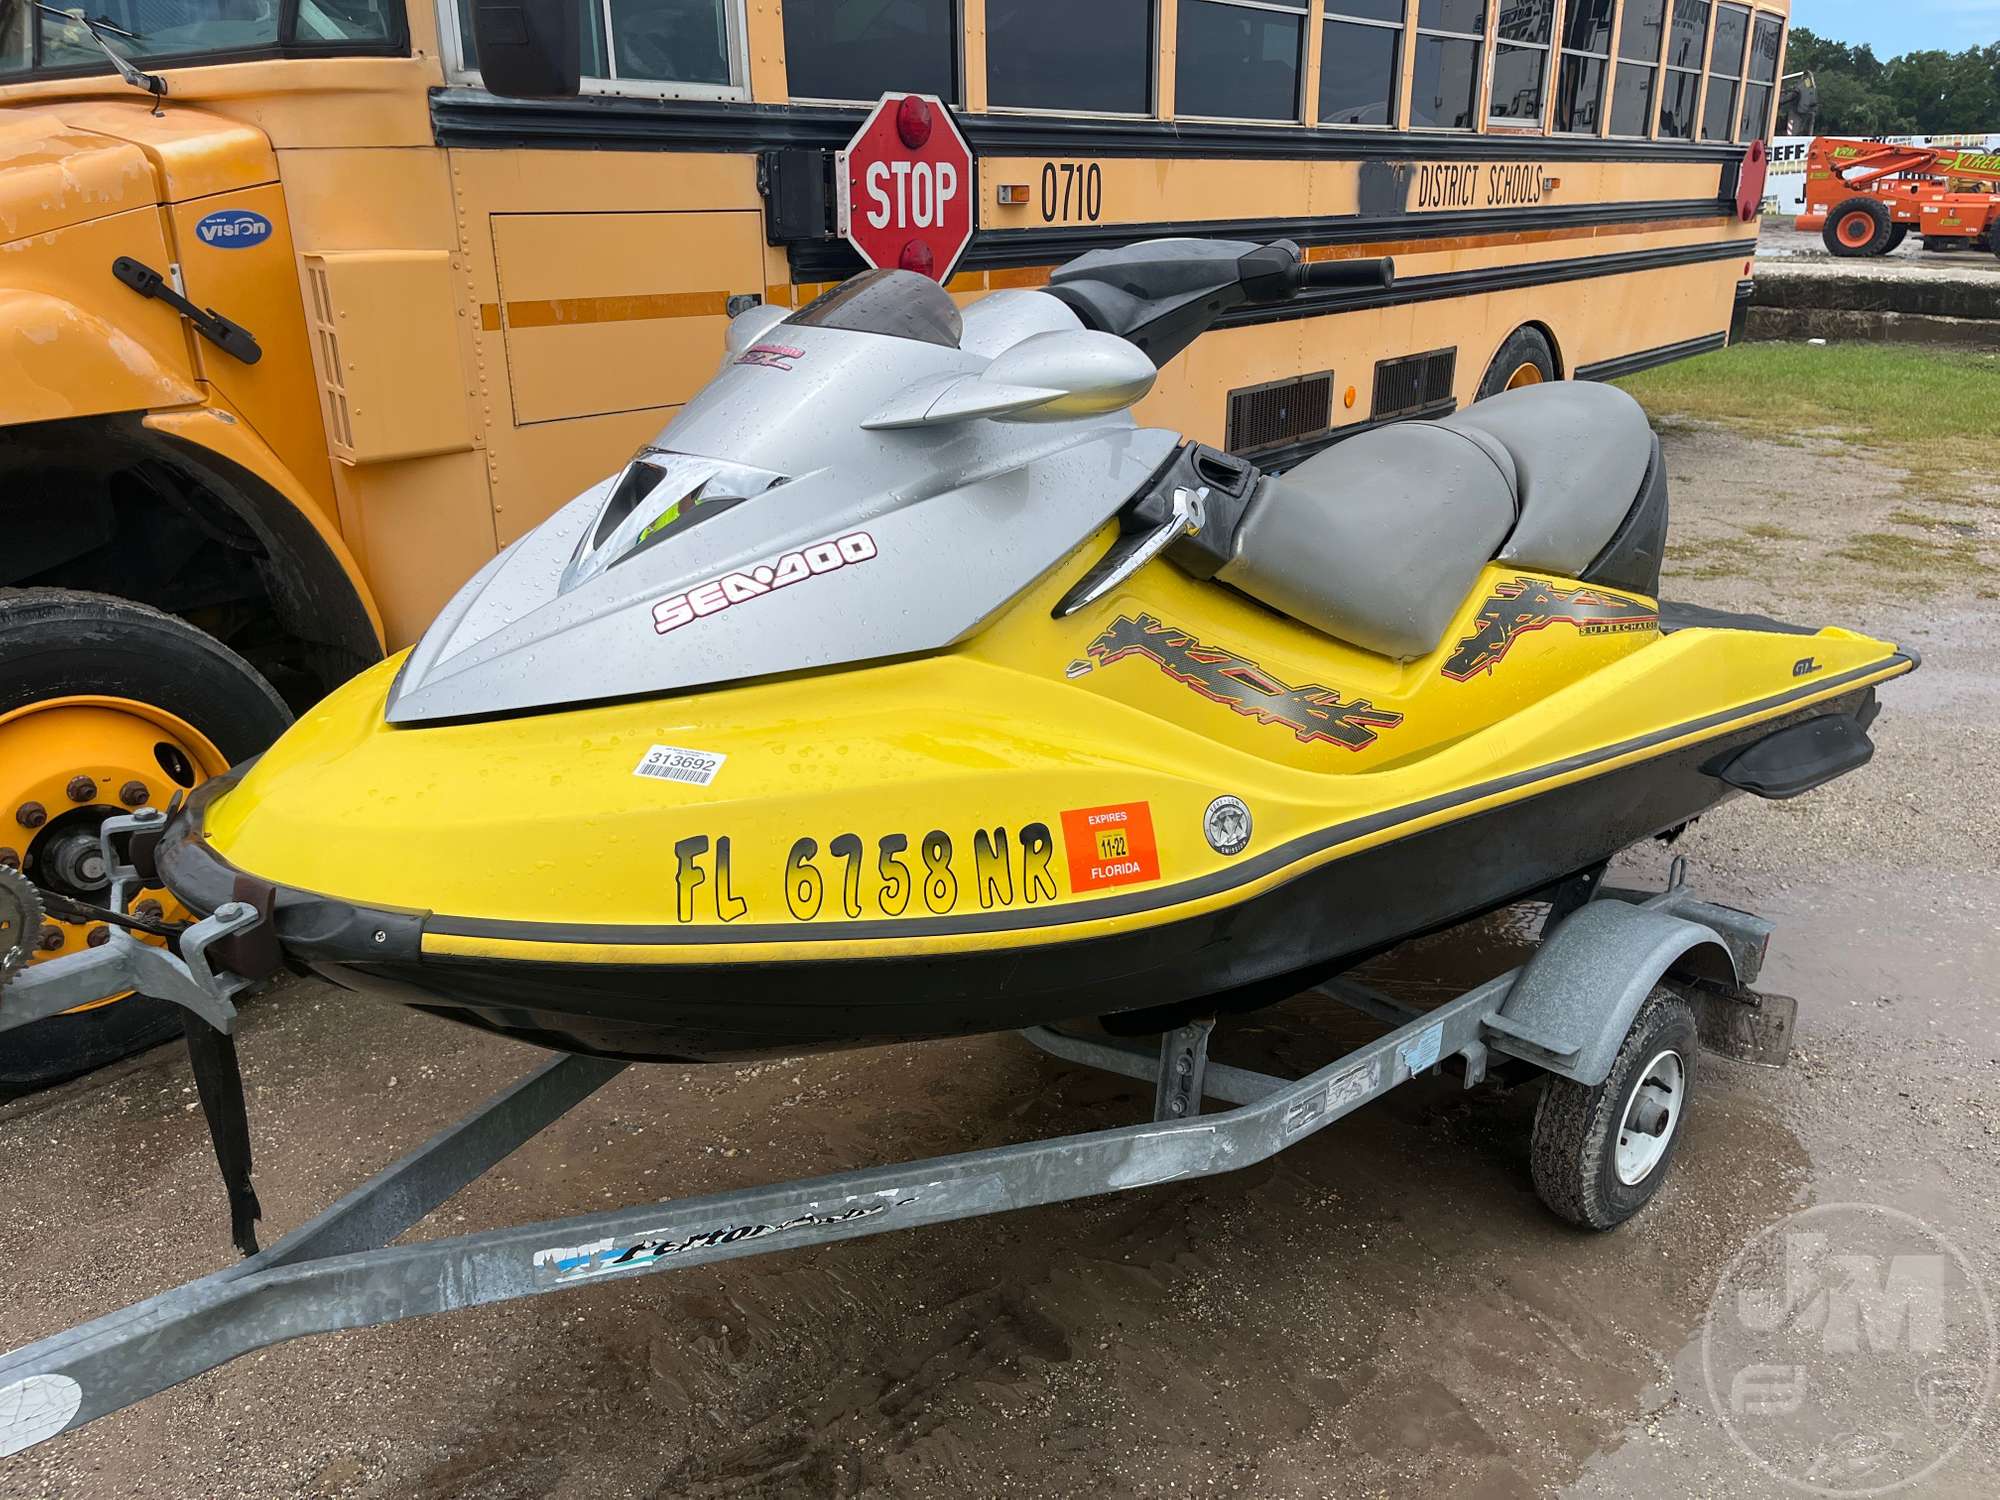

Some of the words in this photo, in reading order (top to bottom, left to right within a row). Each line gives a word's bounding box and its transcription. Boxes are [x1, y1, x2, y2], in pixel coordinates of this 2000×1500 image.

[866, 161, 957, 229] STOP
[1041, 162, 1101, 222] 0710
[1418, 164, 1480, 208] DISTRICT
[1487, 164, 1543, 204] SCHOOLS
[648, 752, 717, 772] 313692
[1088, 811, 1128, 825] EXPIRES
[675, 834, 747, 923] FL
[785, 829, 958, 921] 6758
[974, 822, 1057, 909] NR
[1091, 861, 1141, 879] FLORIDA
